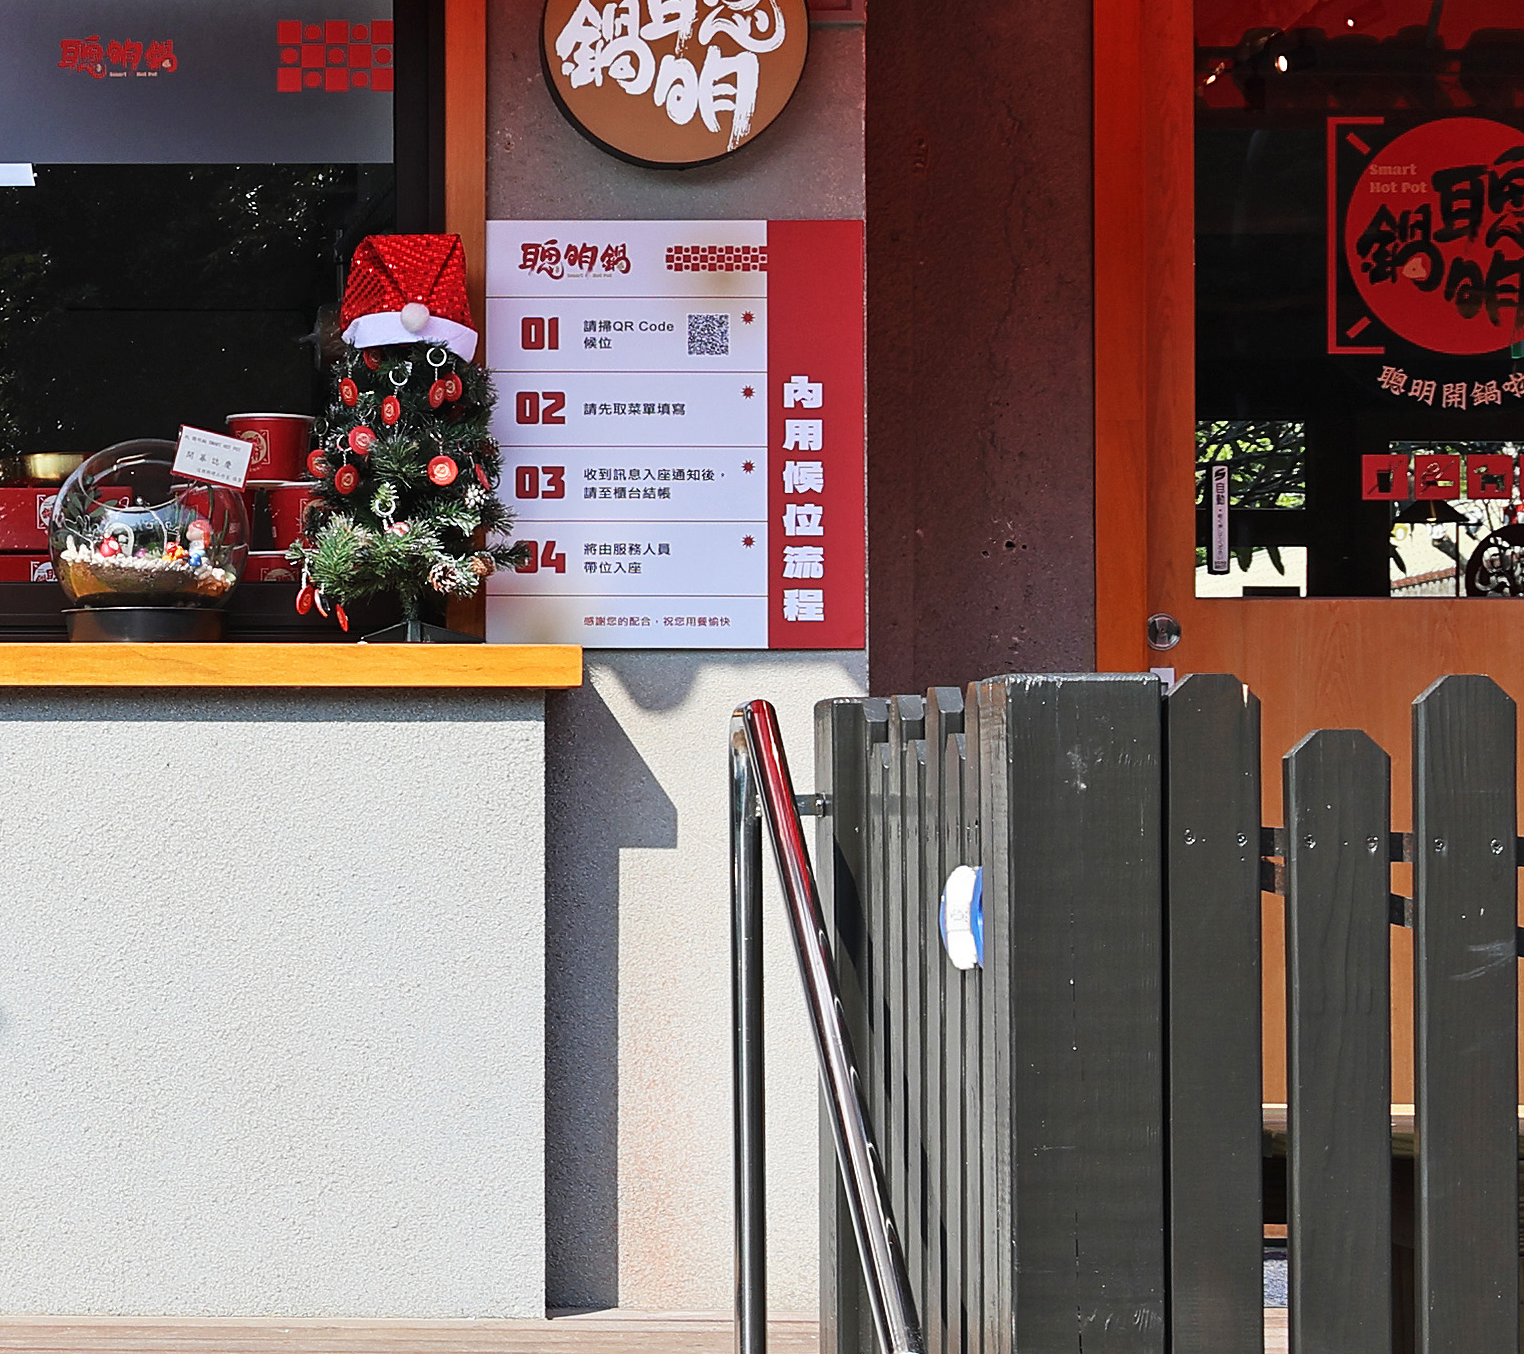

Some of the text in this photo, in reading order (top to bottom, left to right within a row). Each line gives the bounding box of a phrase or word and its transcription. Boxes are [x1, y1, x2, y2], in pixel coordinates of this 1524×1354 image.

[1369, 164, 1417, 175] Smart
[1370, 182, 1427, 193] Hot Pot
[518, 239, 631, 280] 聰明鍋
[638, 321, 674, 332] Code
[521, 317, 560, 350] 01
[584, 336, 612, 349] 候位
[516, 392, 566, 425] 02
[583, 403, 686, 416] 請先取菜單填寫
[515, 466, 565, 499] 03
[583, 487, 671, 499] 請至櫃台結帳
[783, 375, 824, 623] 內用候位流程
[584, 543, 671, 556] 將由服務人員
[514, 541, 566, 573] 04
[584, 561, 642, 574] 帶位入座
